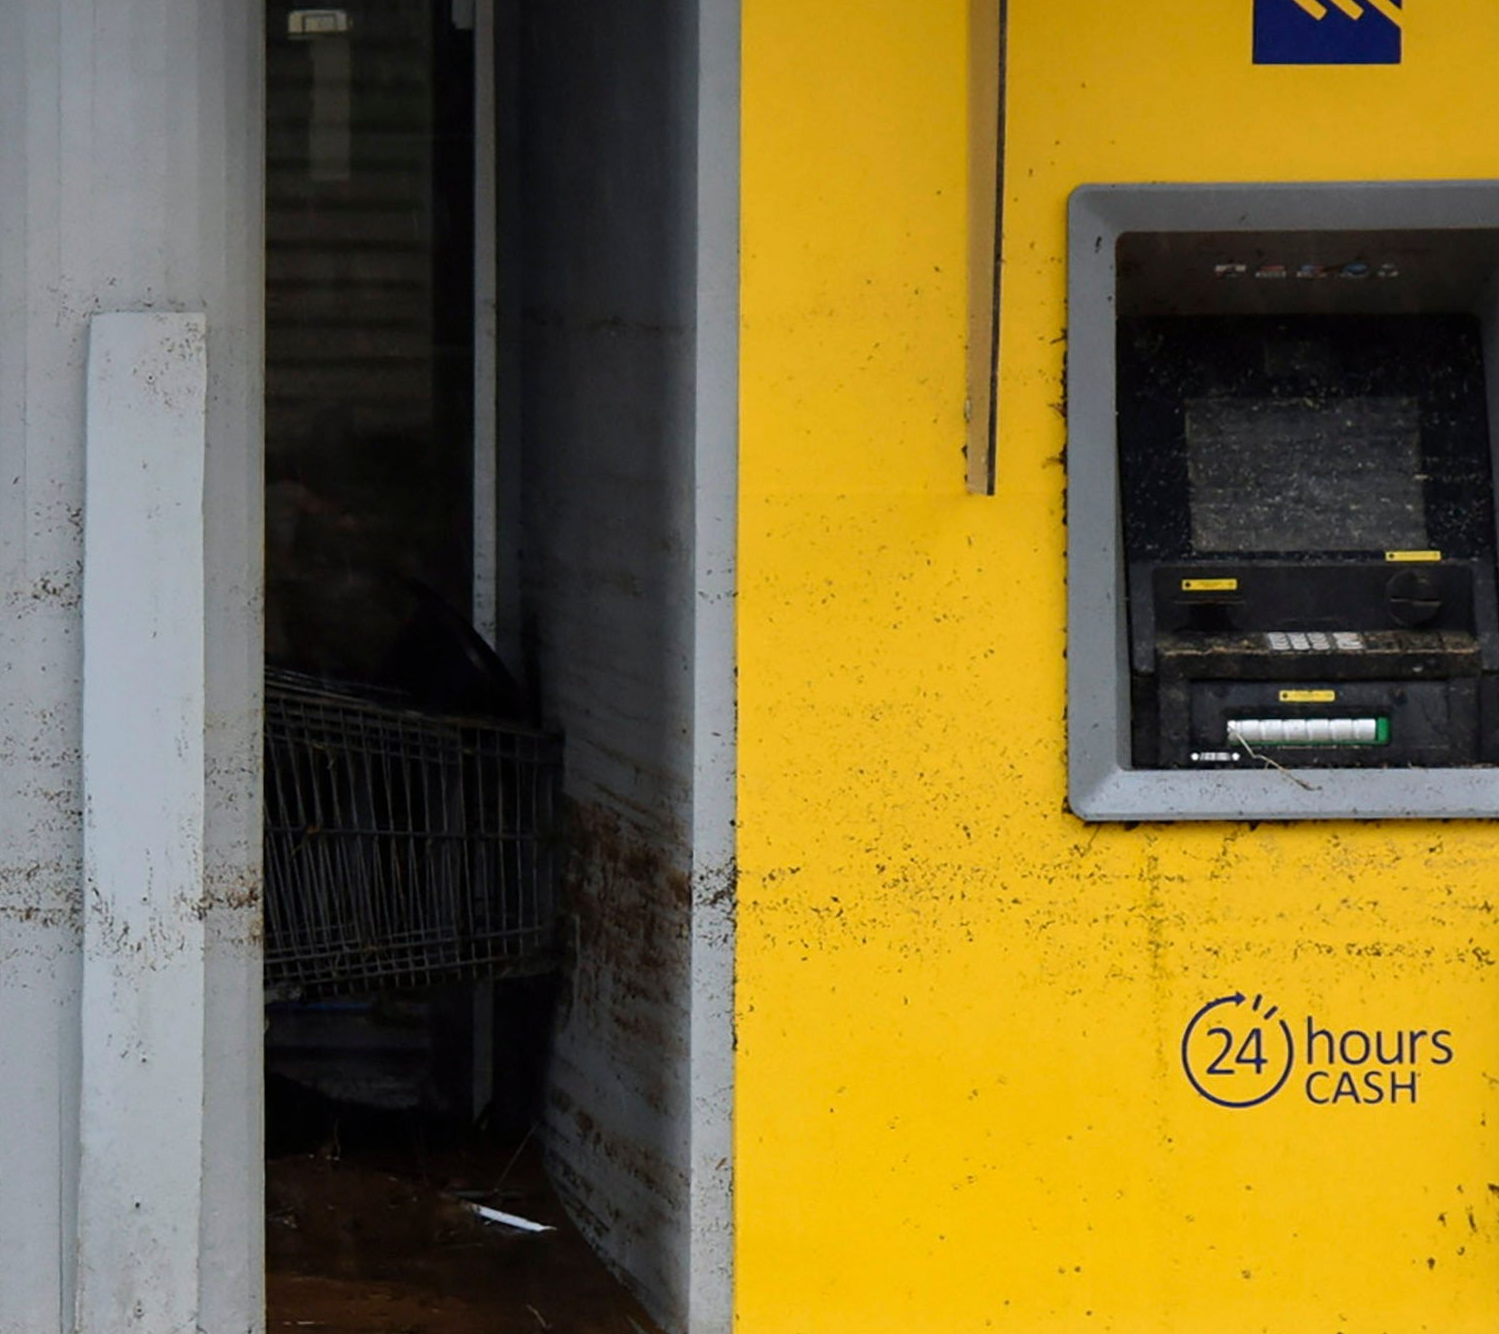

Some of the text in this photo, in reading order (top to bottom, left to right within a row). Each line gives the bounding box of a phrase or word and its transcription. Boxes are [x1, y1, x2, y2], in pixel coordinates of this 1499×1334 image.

[1205, 1016, 1454, 1075] 24 hours
[1305, 1070, 1419, 1105] CASH
